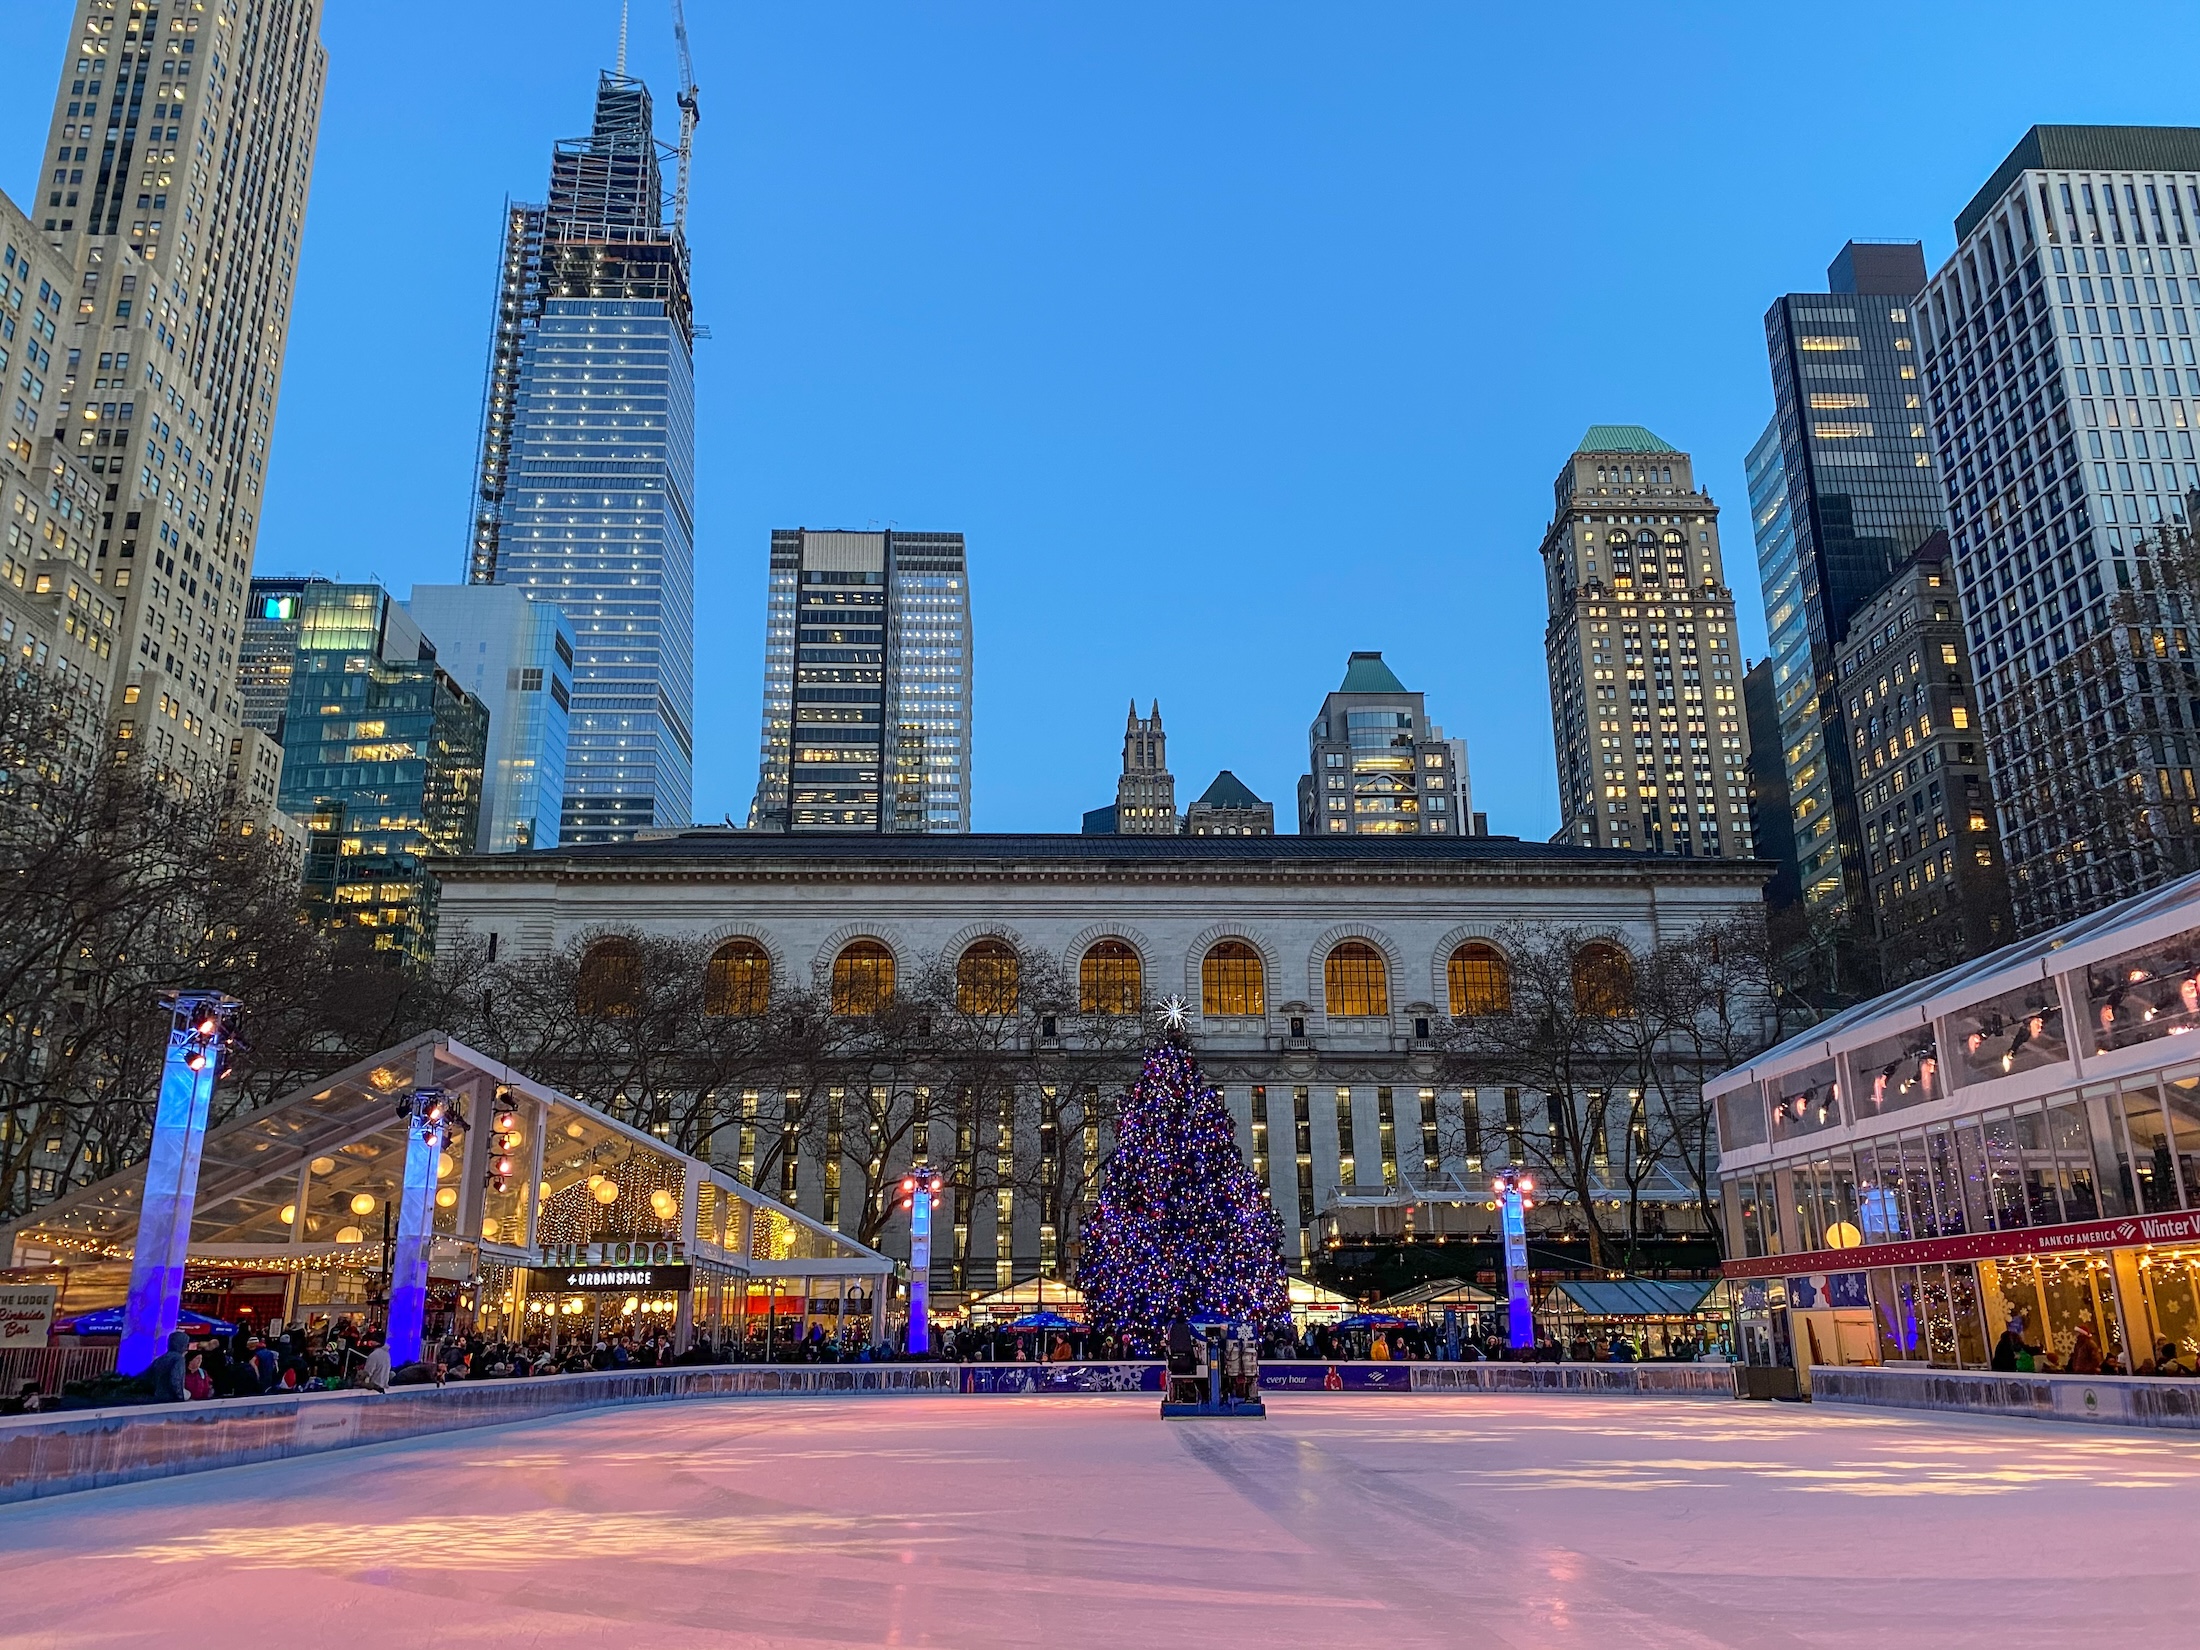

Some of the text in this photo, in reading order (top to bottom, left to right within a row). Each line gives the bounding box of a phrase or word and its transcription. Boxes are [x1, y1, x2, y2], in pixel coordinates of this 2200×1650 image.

[2038, 1235, 2063, 1248] BANK
[2063, 1233, 2075, 1245] OF
[2076, 1230, 2118, 1244] AMERICA
[2140, 1219, 2190, 1239] Winter
[538, 1241, 686, 1267] THE LODGE
[578, 1271, 652, 1286] URBANSPACE
[17, 1295, 49, 1305] LODGE
[4, 1321, 30, 1338] Bar
[1266, 1375, 1307, 1385] every hour
